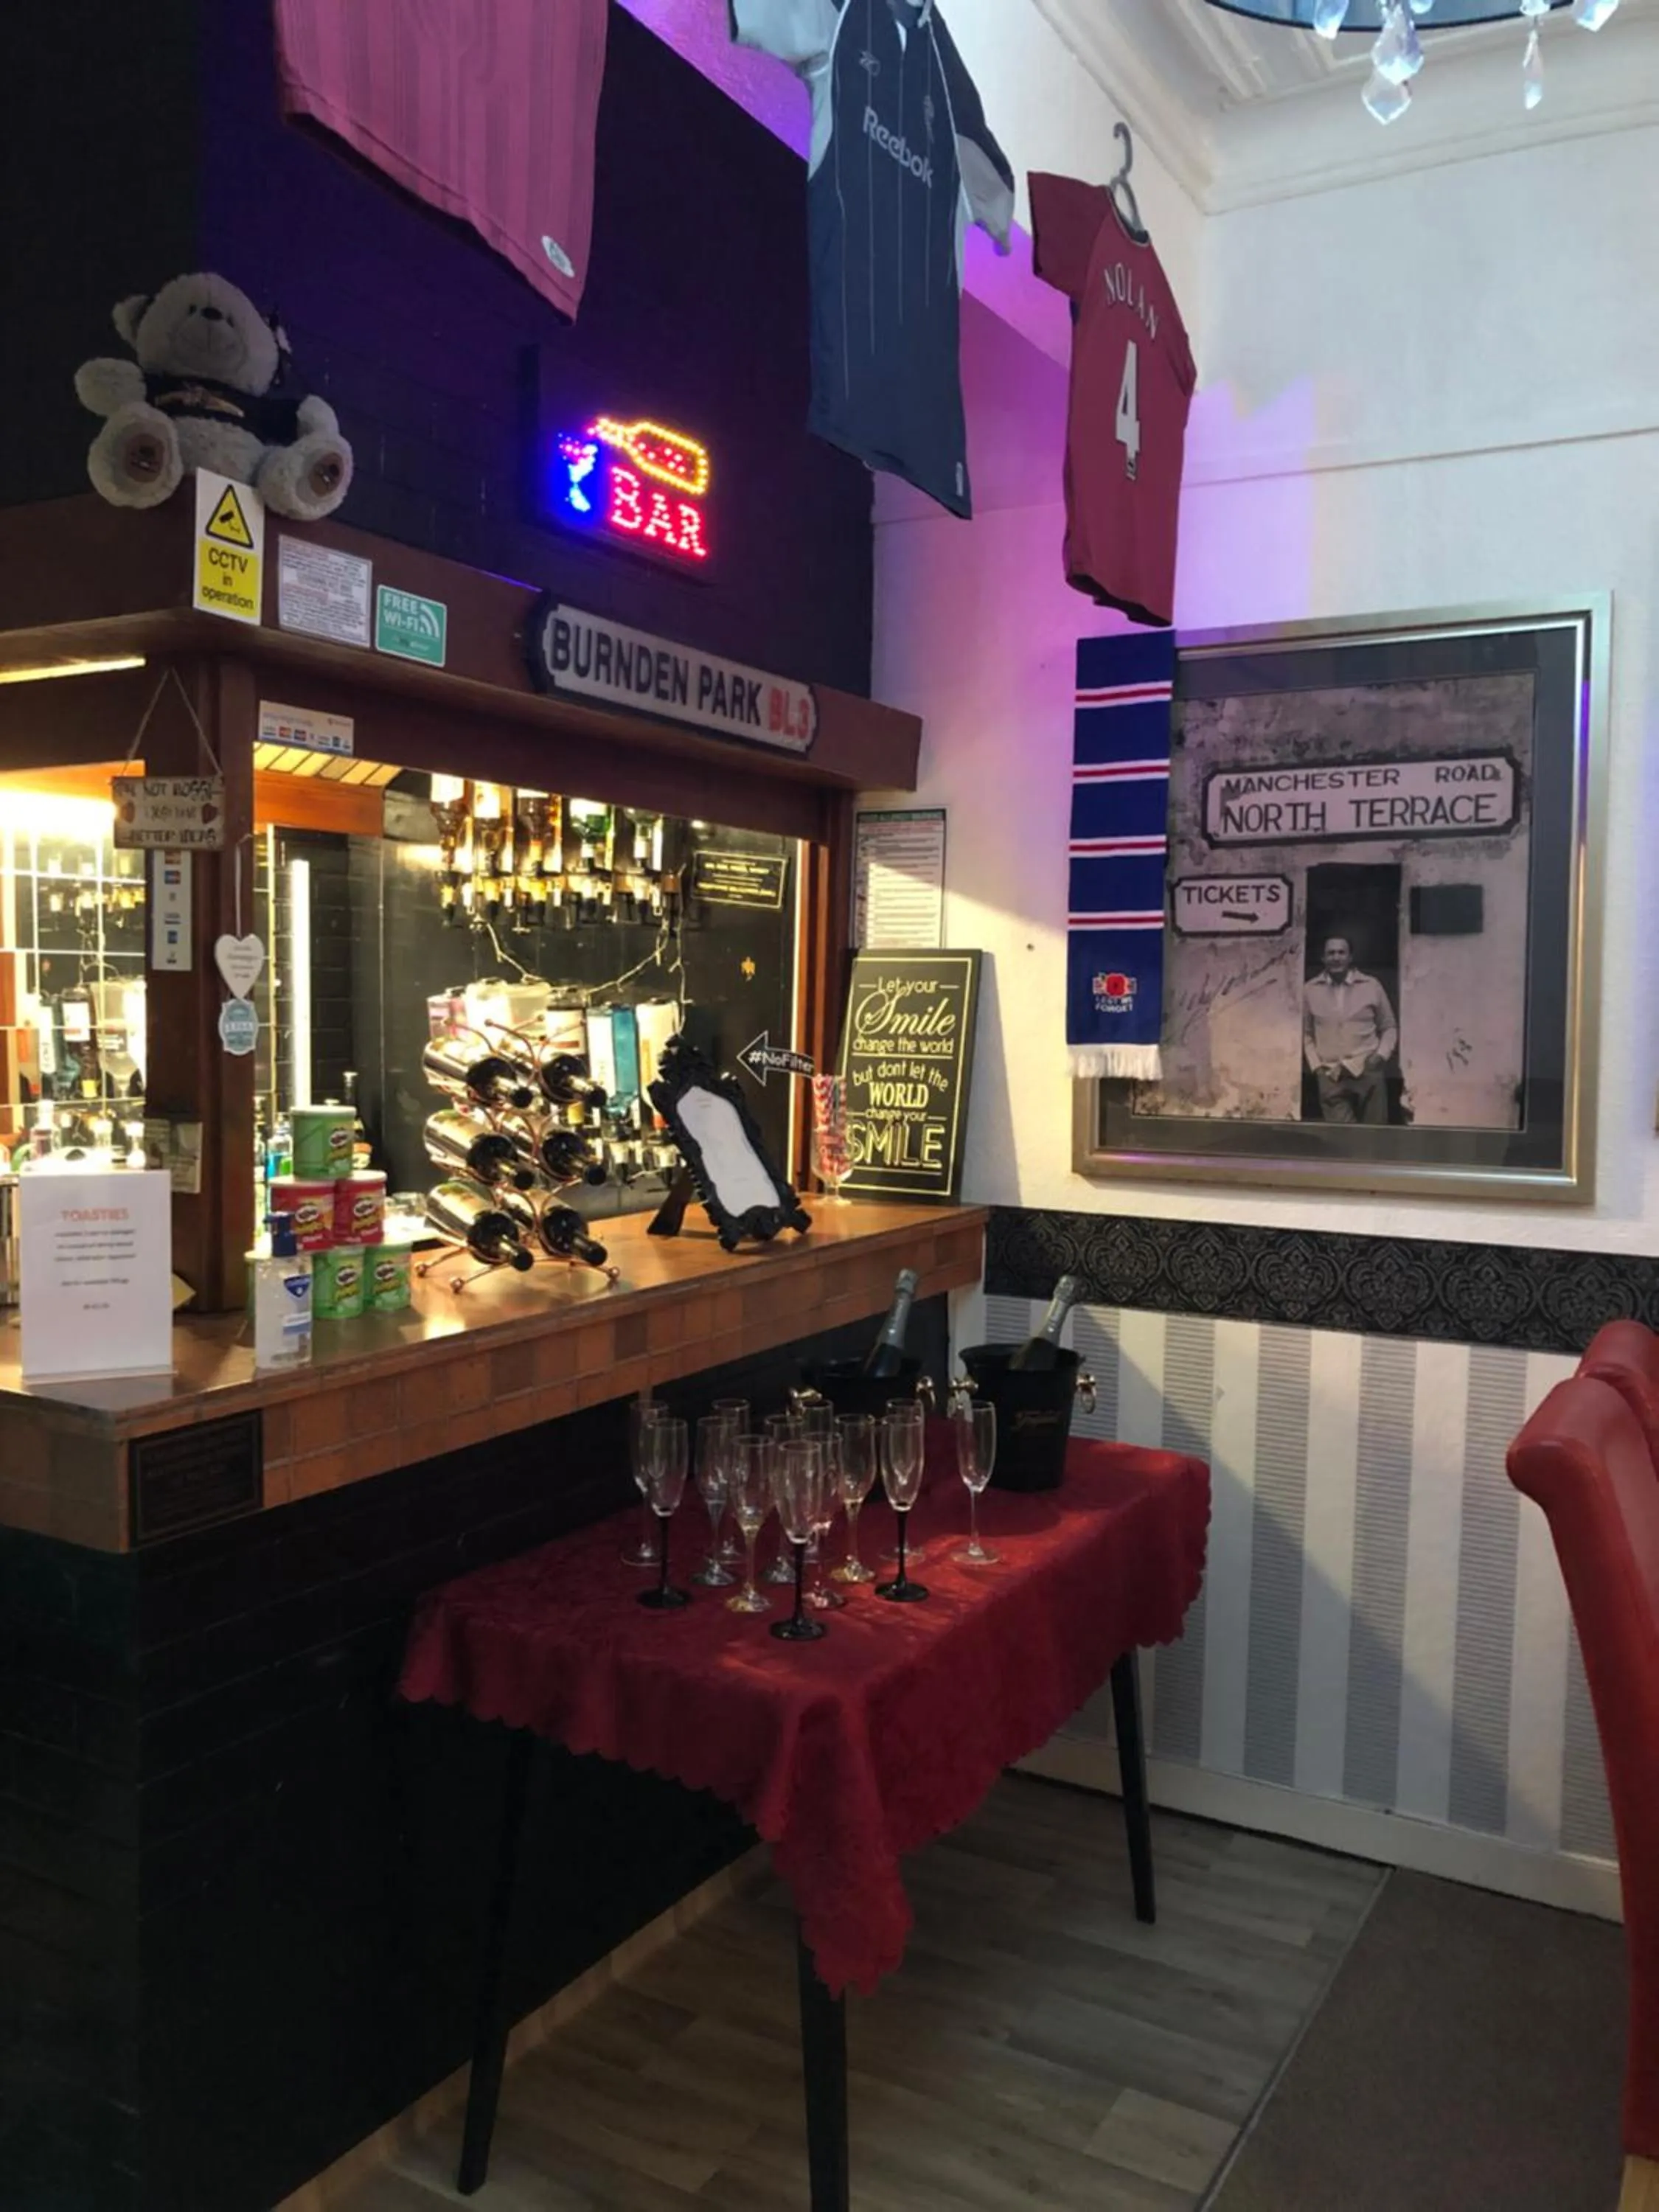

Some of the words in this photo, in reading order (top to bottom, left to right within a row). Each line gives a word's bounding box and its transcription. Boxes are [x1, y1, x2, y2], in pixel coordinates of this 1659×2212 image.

[863, 105, 934, 189] Reebok
[1104, 262, 1159, 339] NOLAN
[1116, 339, 1141, 481] 4
[611, 466, 706, 556] BAR
[208, 547, 248, 574] CCTV
[222, 572, 233, 587] in
[201, 585, 254, 610] operation
[383, 592, 420, 616] FREE
[552, 617, 689, 706] BURNDEN
[698, 664, 762, 726] PARK
[1225, 768, 1400, 794] MANCHESTER
[1222, 801, 1326, 833] NORTH
[1349, 793, 1498, 827] TERRACE
[1182, 885, 1281, 905] TICKETS
[877, 976, 902, 993] Let
[905, 980, 939, 997] your
[855, 987, 956, 1036] Smile
[852, 1034, 894, 1056] change
[897, 1036, 917, 1052] the
[919, 1037, 954, 1054] world
[852, 1064, 873, 1087] but
[877, 1060, 907, 1078] dont
[909, 1062, 925, 1080] let
[928, 1067, 949, 1092] the
[869, 1081, 929, 1108] WORLD
[865, 1107, 902, 1121] change
[902, 1110, 927, 1122] your
[846, 1119, 945, 1169] SMILE
